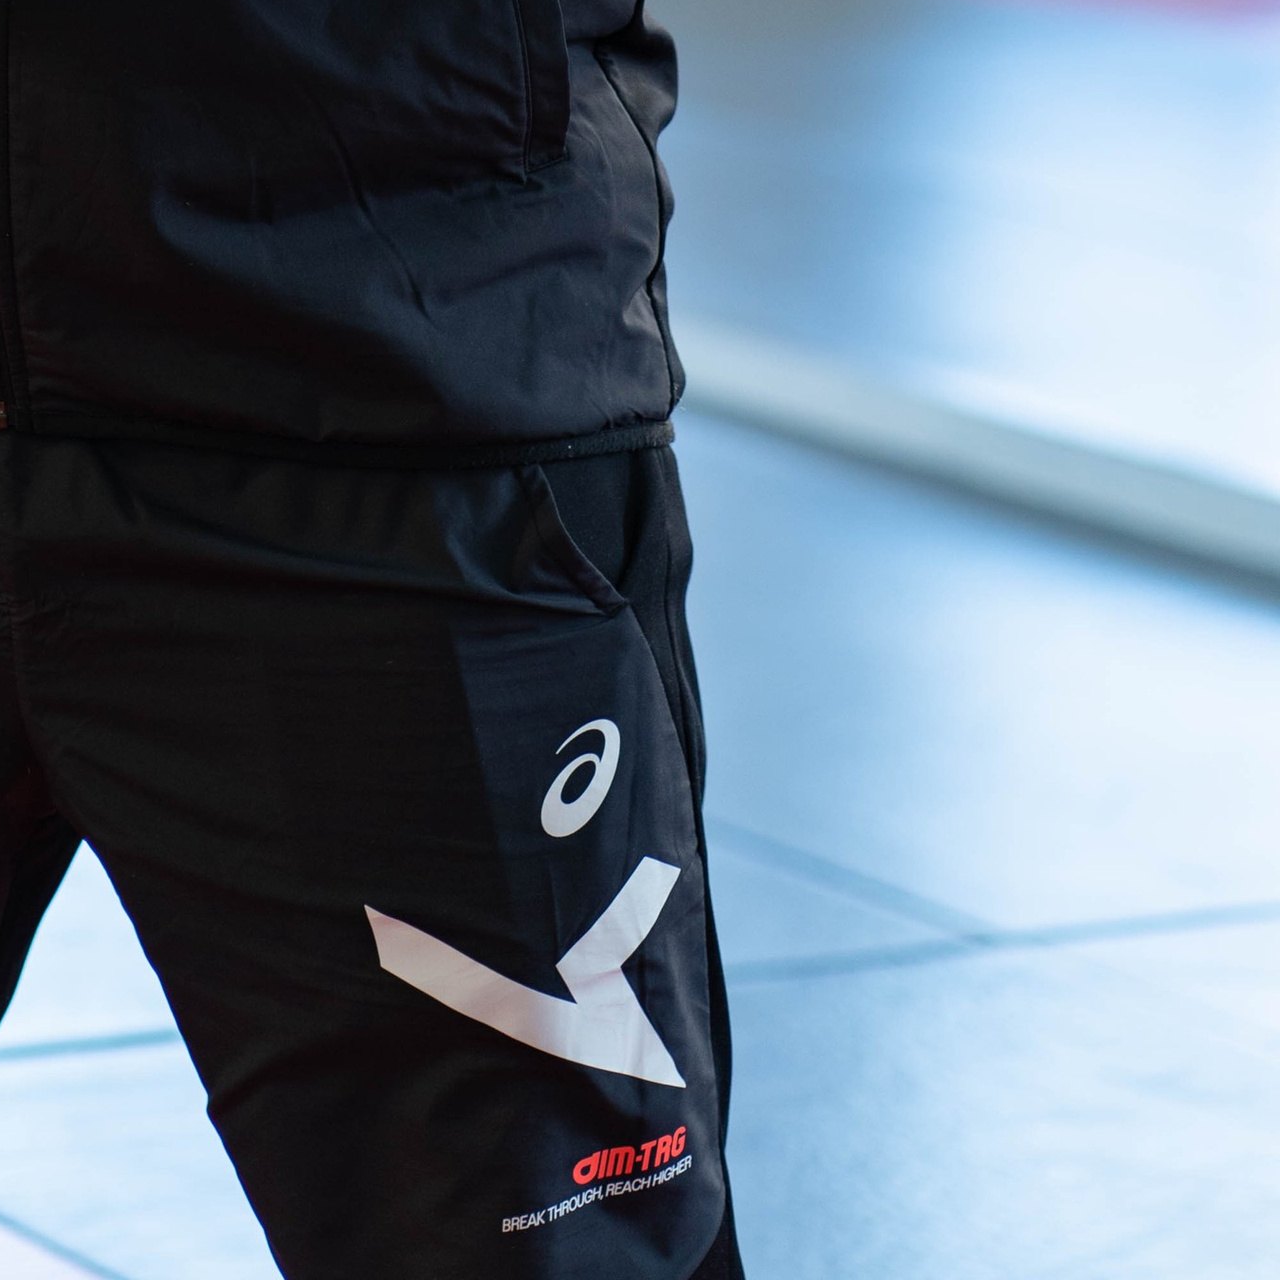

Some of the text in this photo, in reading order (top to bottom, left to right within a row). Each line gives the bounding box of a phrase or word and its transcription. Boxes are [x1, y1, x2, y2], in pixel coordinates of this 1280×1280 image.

[502, 1154, 693, 1233] BREAK THROUGH, REACH HIGHER
